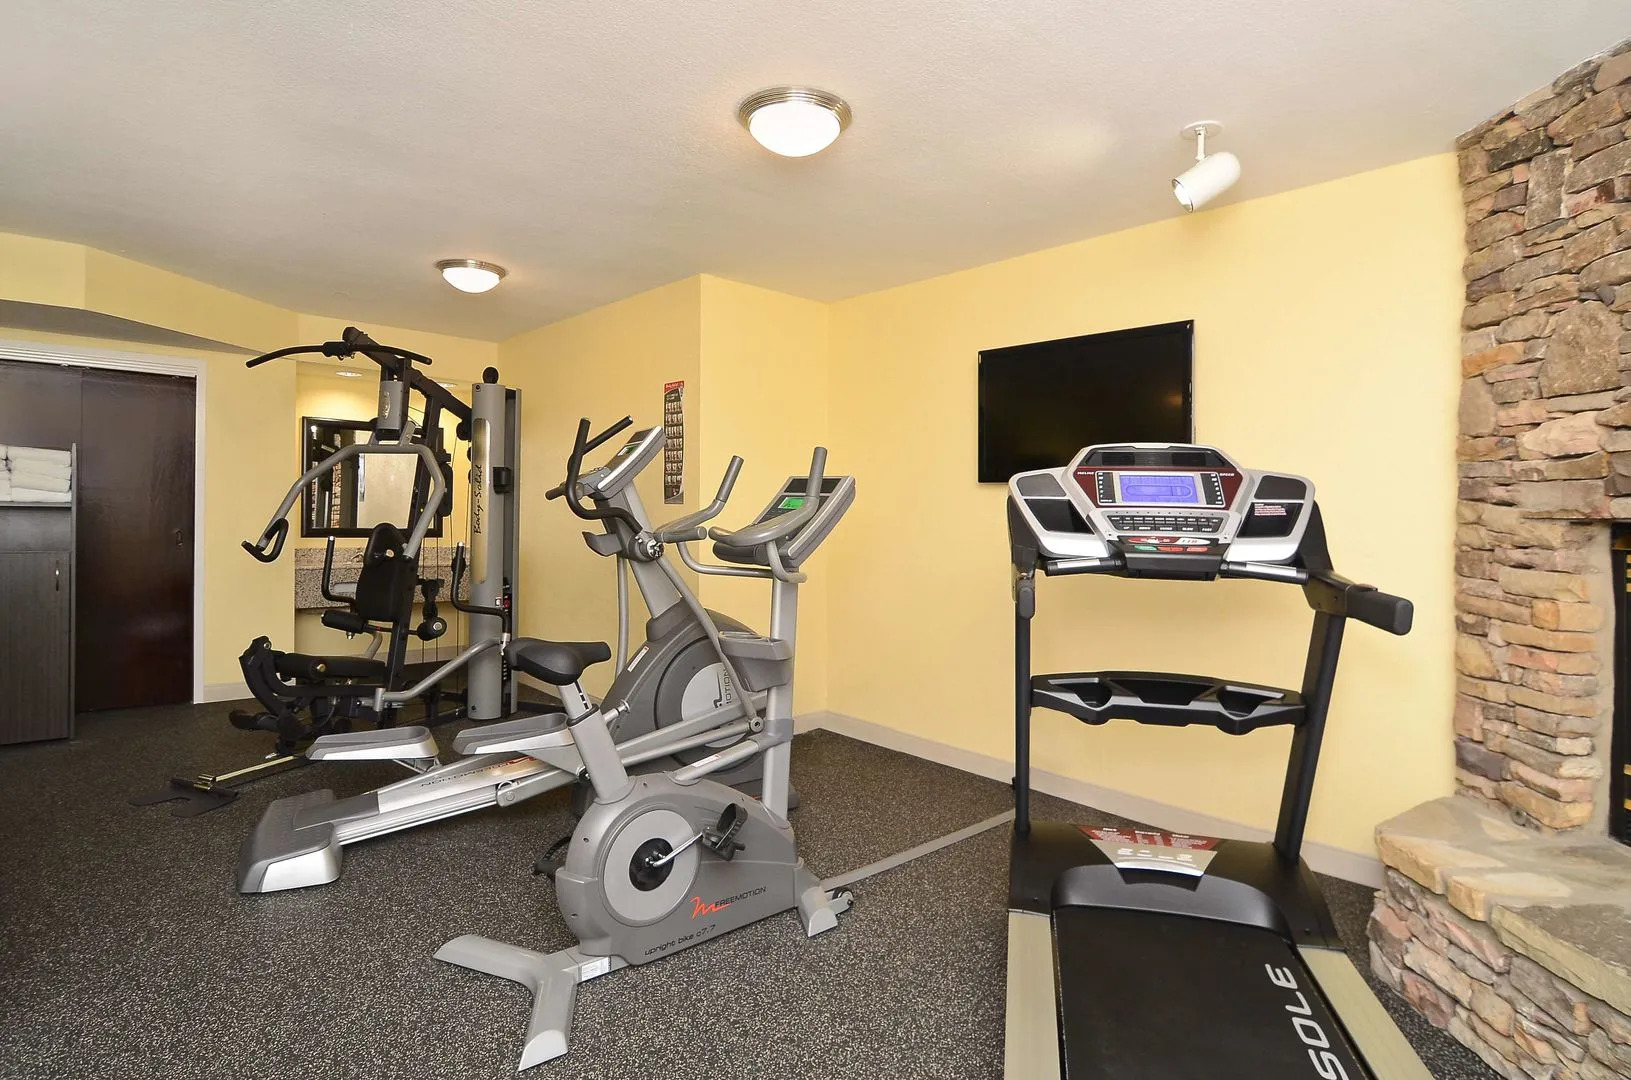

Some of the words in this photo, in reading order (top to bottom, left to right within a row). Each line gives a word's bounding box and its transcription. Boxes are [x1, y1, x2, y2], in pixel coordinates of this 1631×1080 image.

[472, 464, 484, 535] Body-Solid
[714, 886, 767, 908] FREEMOTION
[644, 939, 676, 956] upright
[677, 933, 694, 944] bike
[1264, 963, 1350, 1080] SOLE
